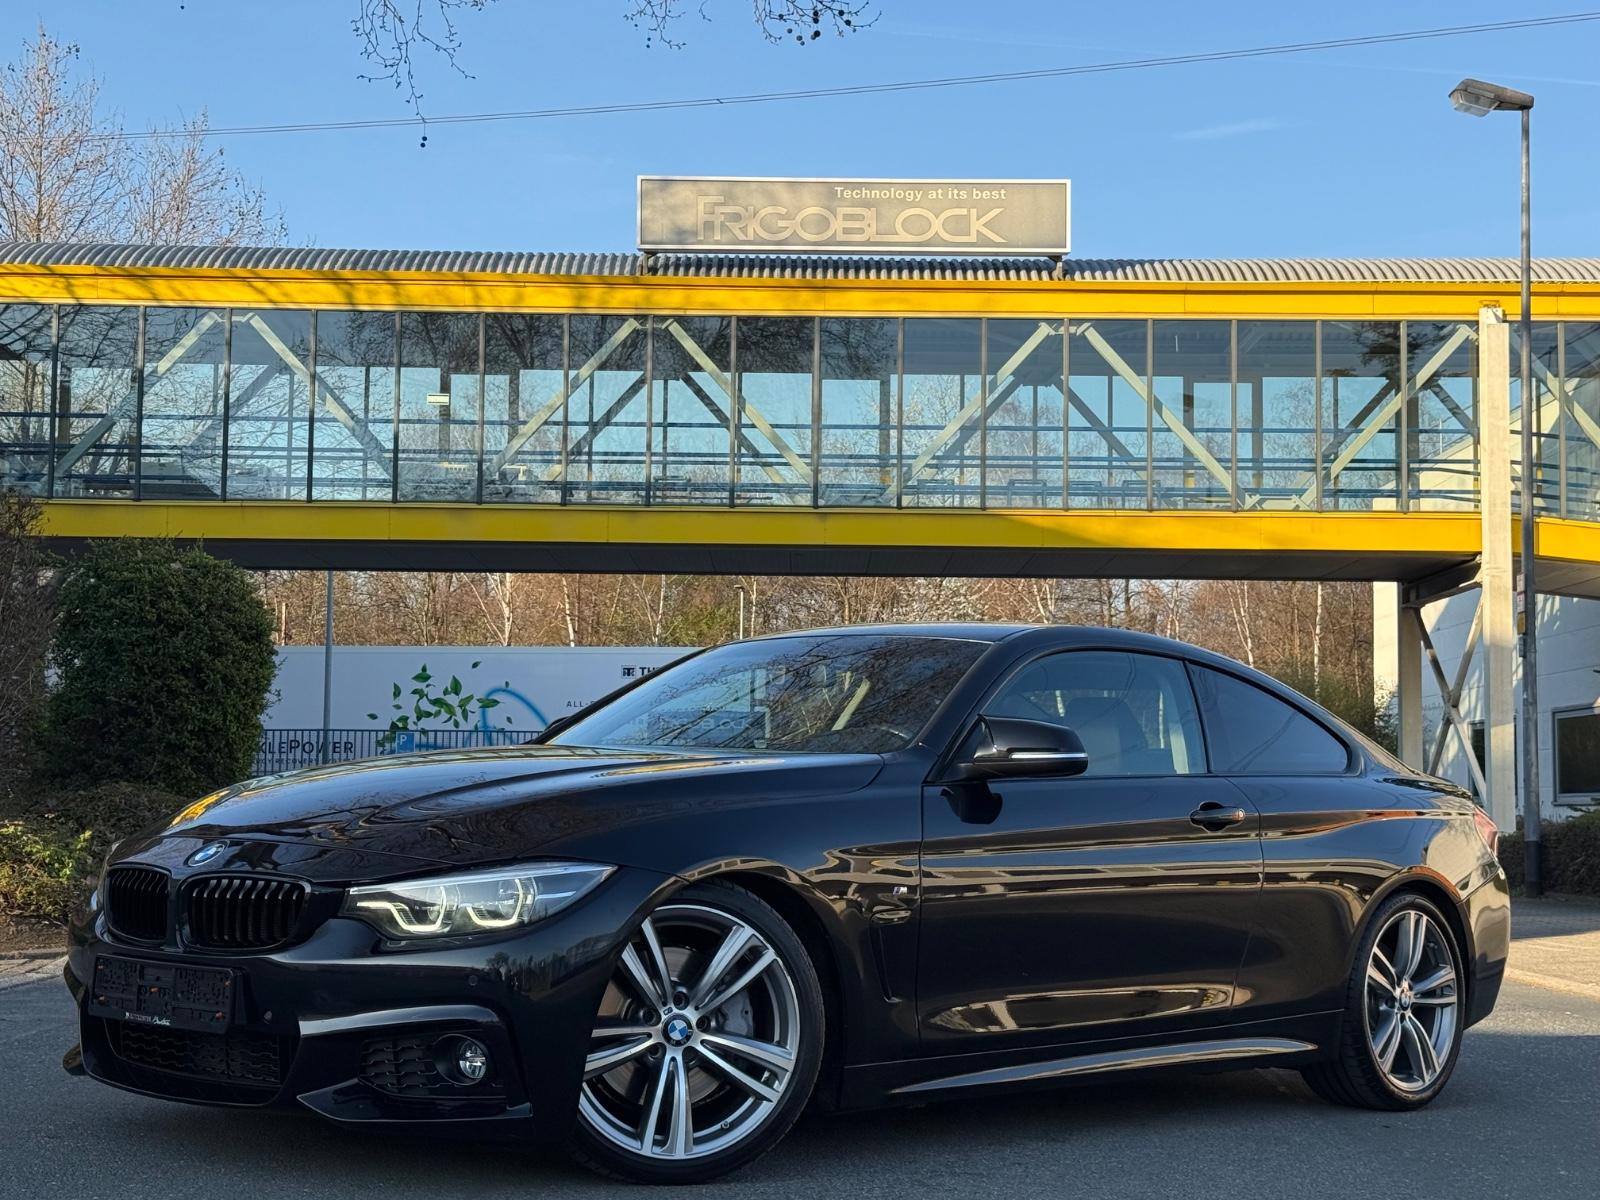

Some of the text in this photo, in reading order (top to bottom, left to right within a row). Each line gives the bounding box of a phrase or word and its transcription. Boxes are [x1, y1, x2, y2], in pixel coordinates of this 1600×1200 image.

[834, 186, 1007, 201] Technology at its best
[696, 195, 1009, 243] FRIGOBLOCK
[400, 734, 407, 745] P
